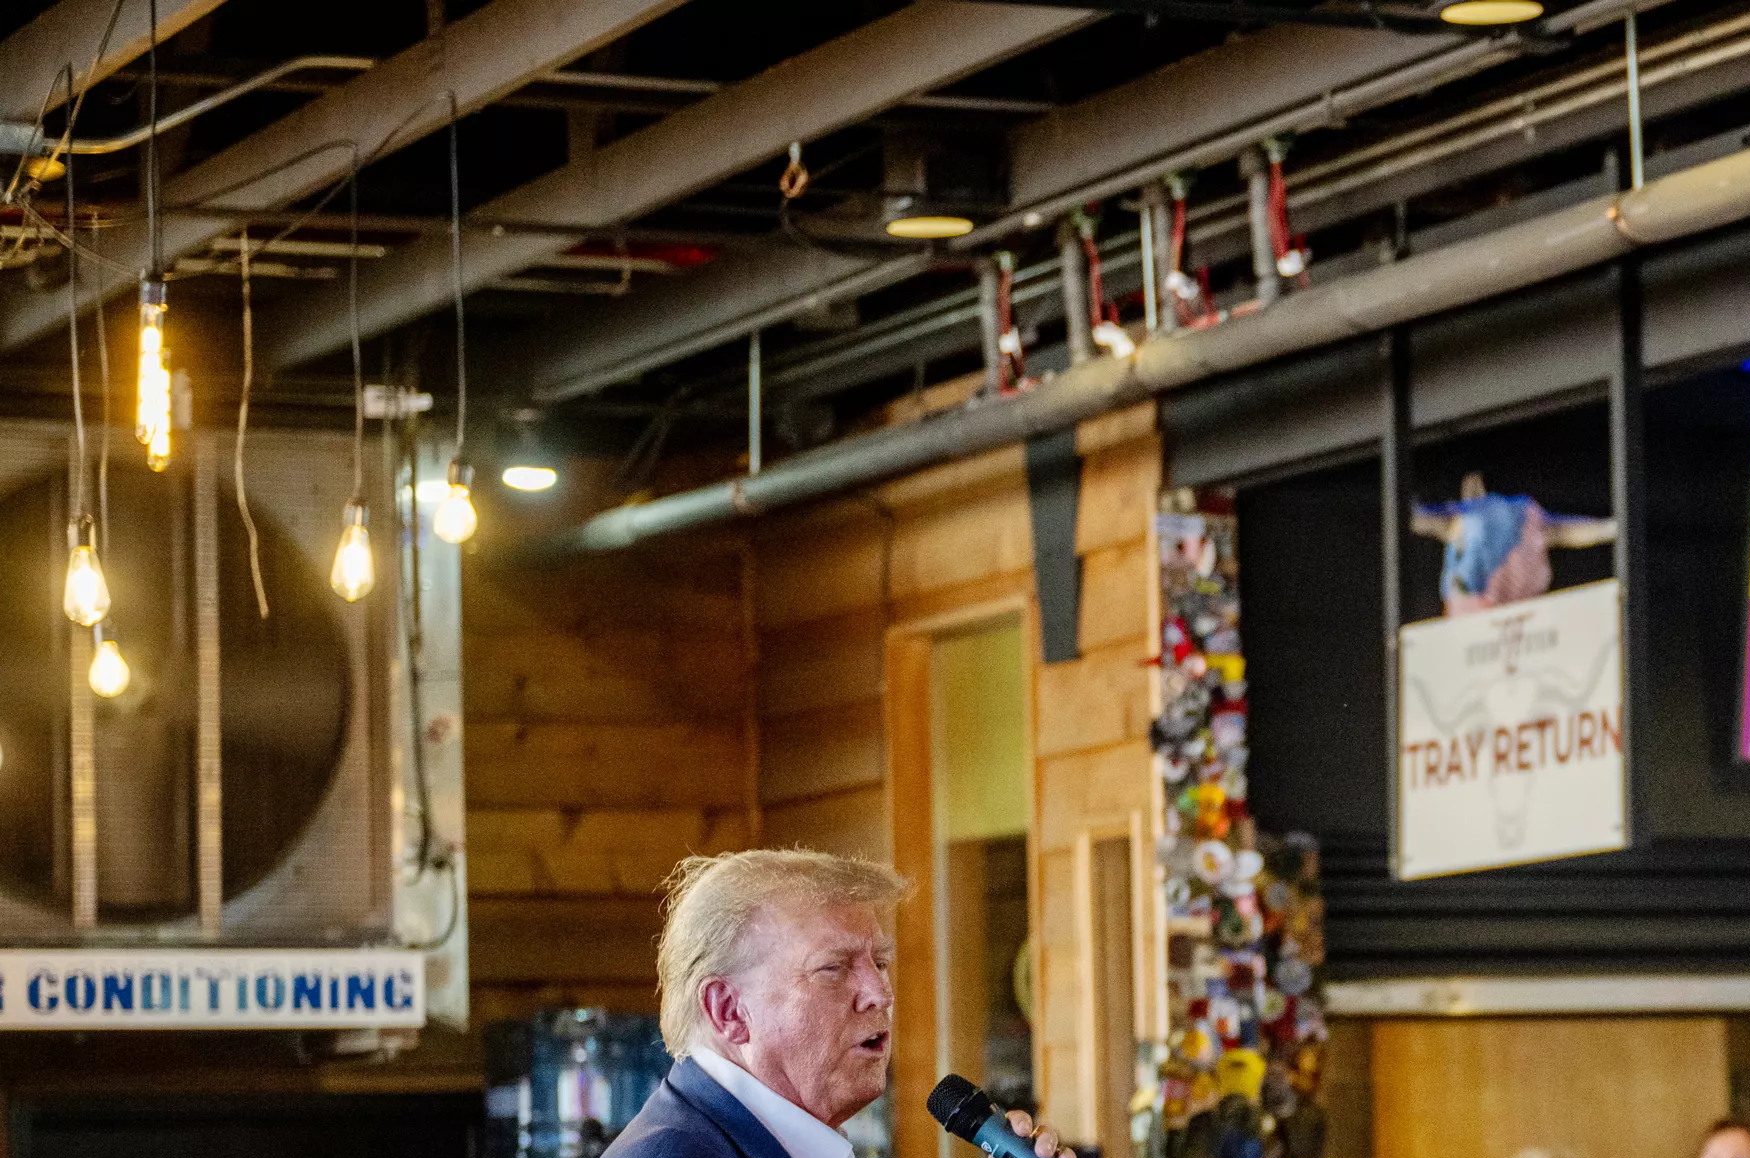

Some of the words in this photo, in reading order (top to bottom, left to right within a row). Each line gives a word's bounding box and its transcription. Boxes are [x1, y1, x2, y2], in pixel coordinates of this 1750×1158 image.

[1404, 730, 1486, 790] TRAY
[1494, 705, 1624, 774] RETURN
[26, 966, 415, 1013] CONDITIONING
